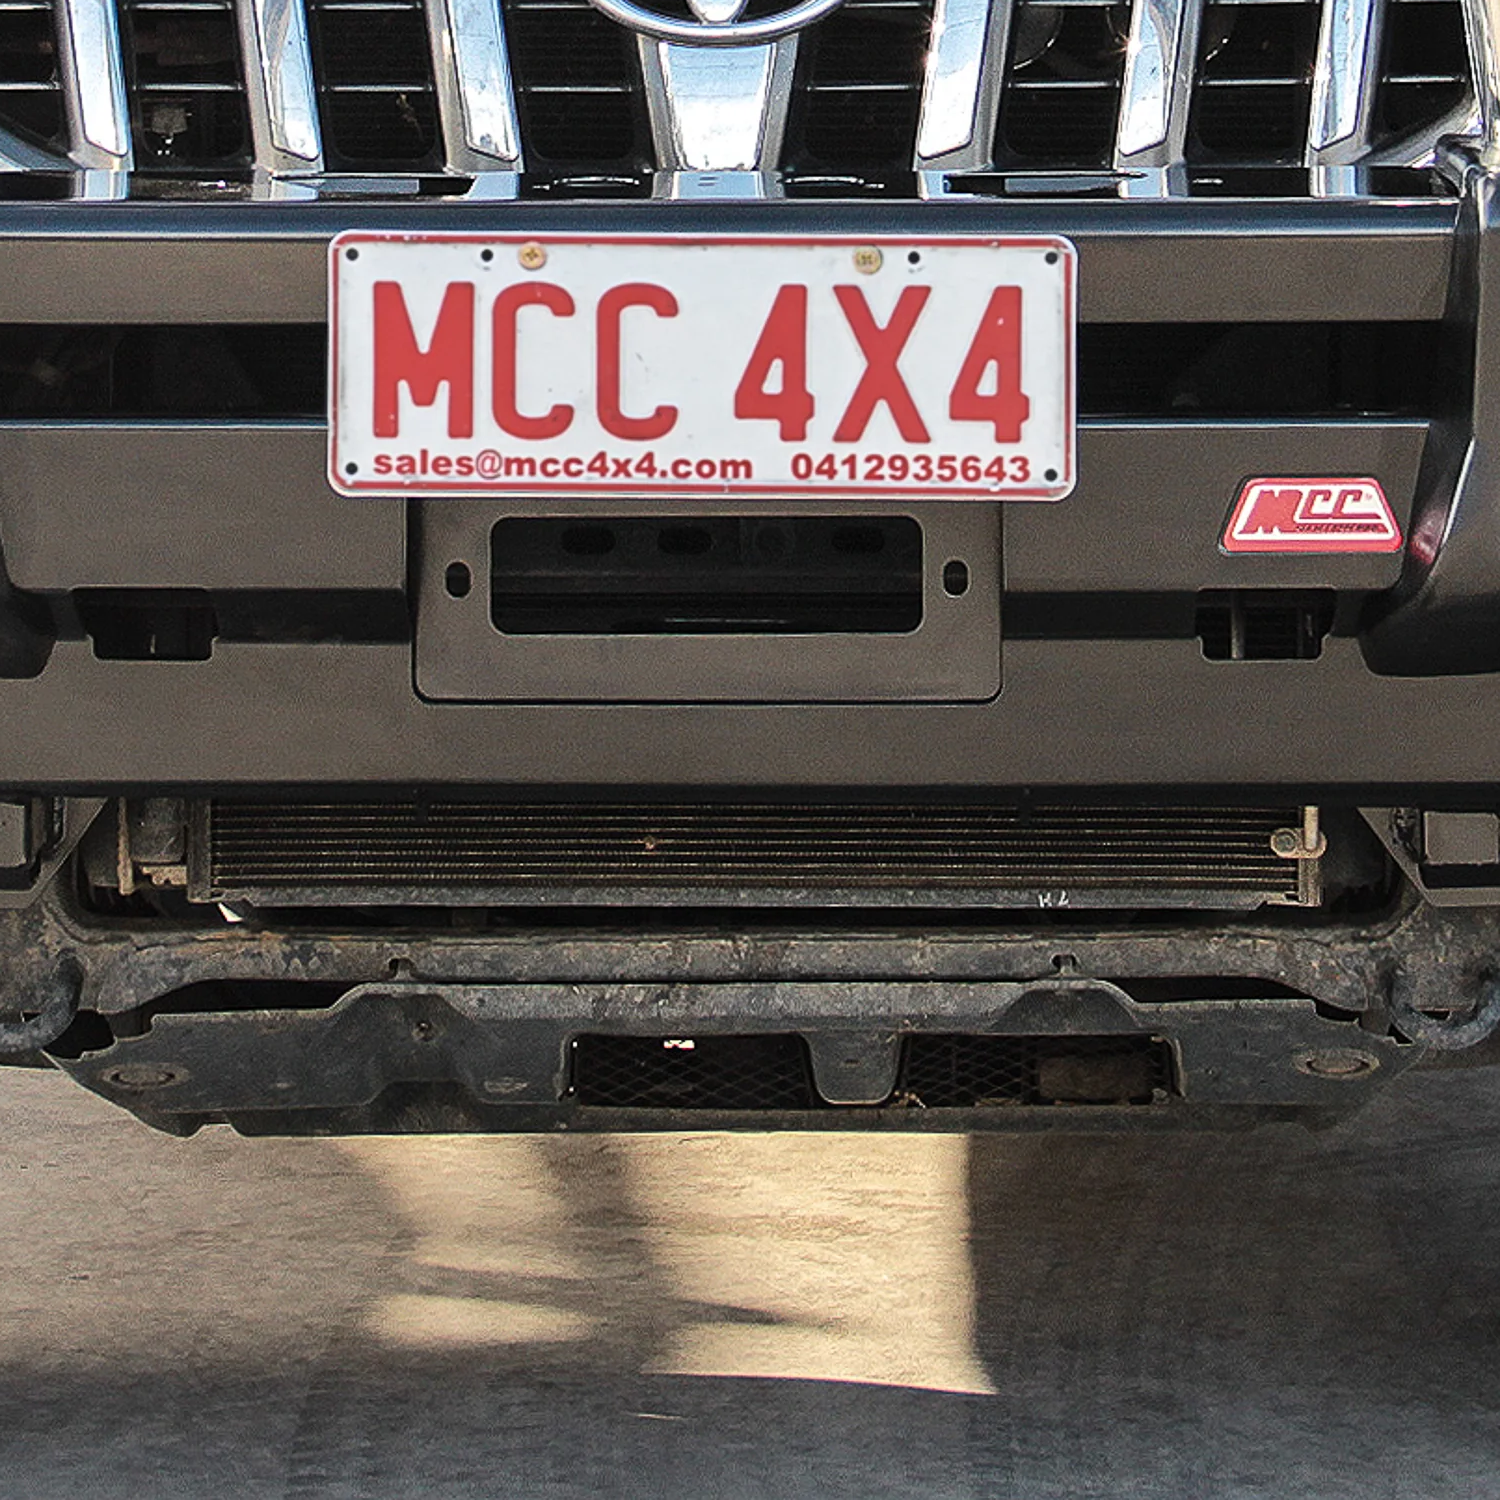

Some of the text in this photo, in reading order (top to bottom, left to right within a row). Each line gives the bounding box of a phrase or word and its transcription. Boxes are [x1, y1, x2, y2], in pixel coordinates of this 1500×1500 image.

[372, 280, 1031, 443] MCC 4X4
[373, 449, 1031, 483] sales@mcc4x4.com 0412935643
